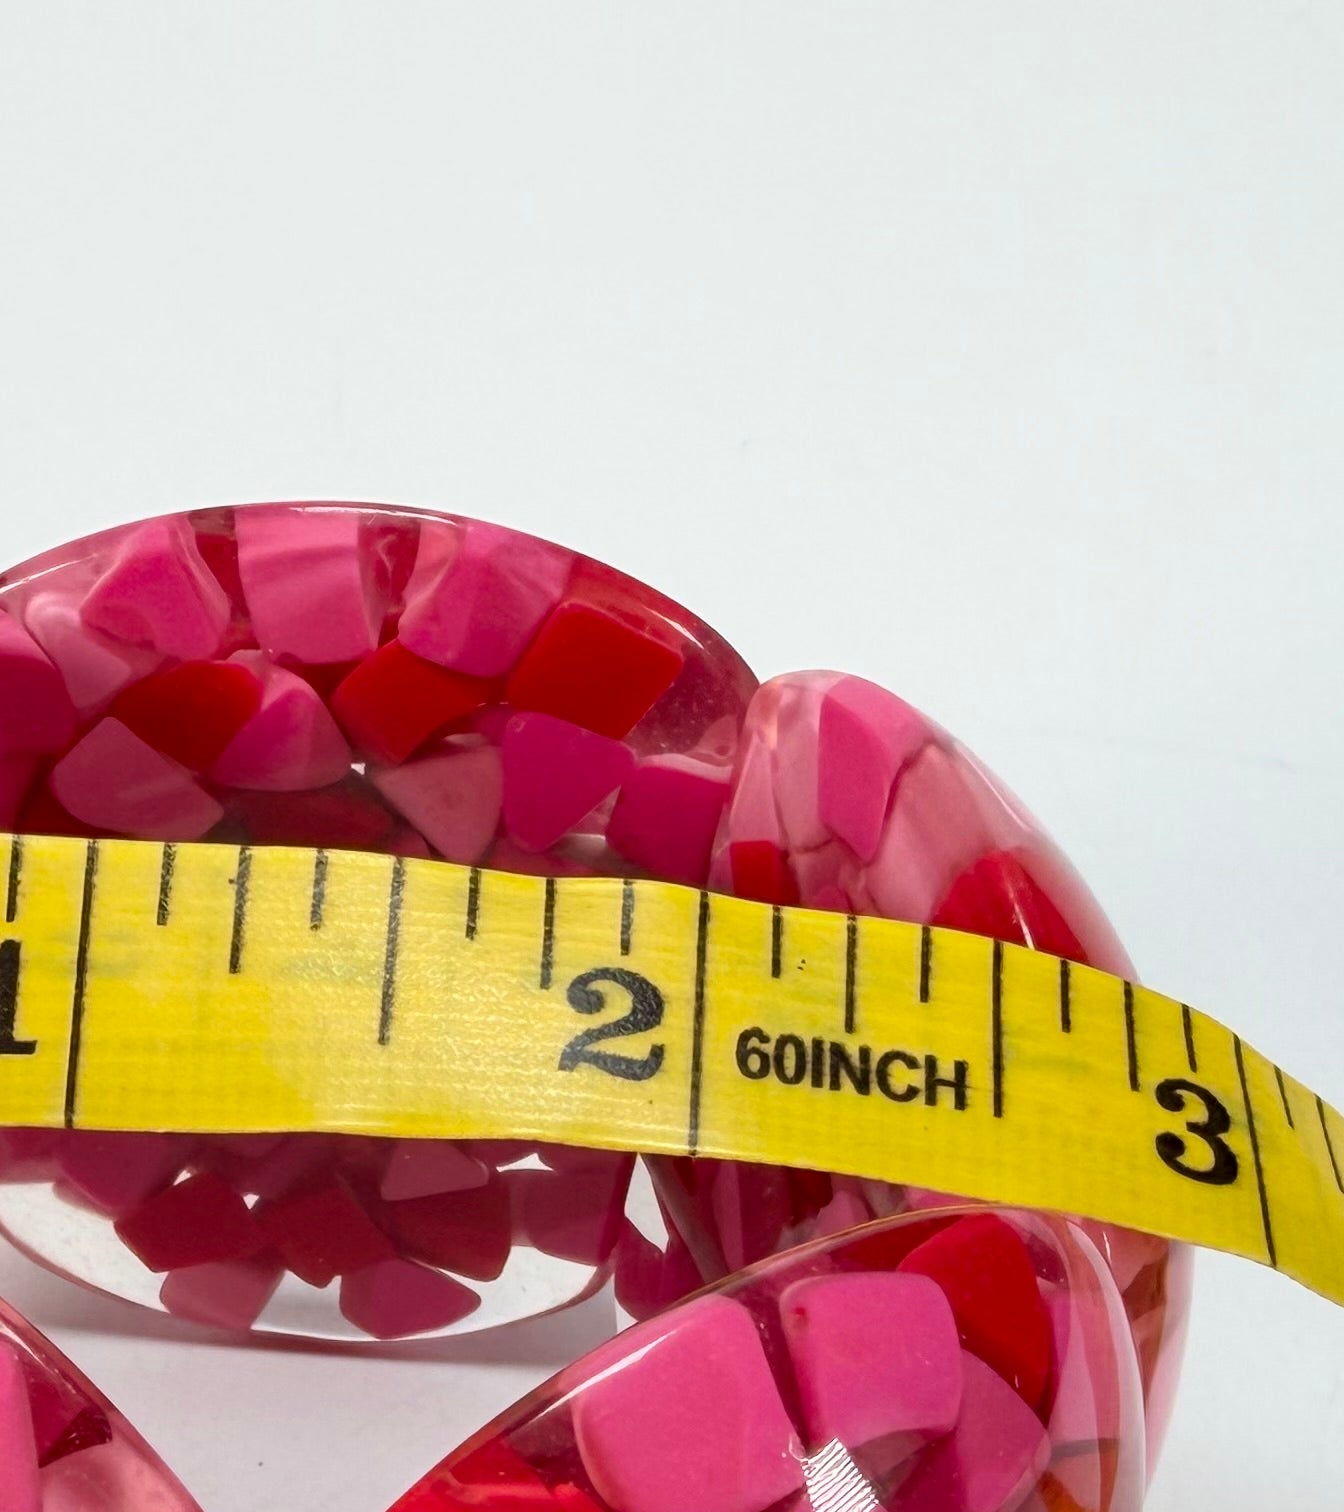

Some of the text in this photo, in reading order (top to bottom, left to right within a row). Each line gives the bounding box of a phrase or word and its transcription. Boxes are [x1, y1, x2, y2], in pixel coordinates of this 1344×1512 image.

[558, 967, 666, 1082] 2
[734, 1026, 971, 1112] 60INCH
[1155, 1078, 1240, 1186] 3
